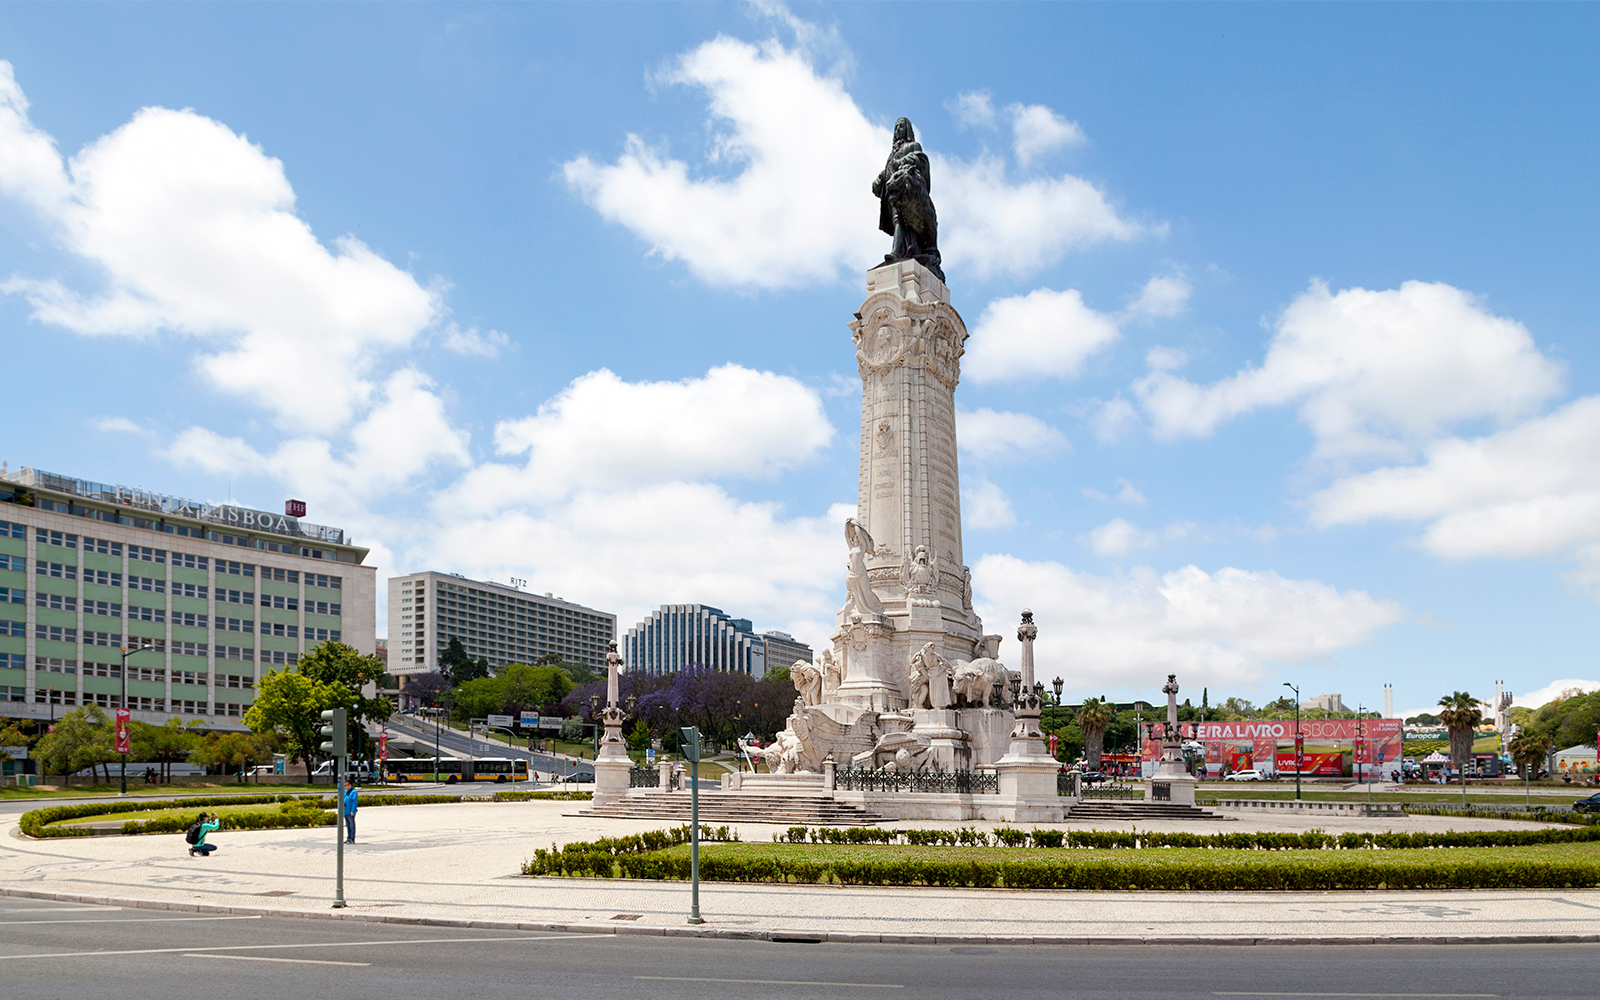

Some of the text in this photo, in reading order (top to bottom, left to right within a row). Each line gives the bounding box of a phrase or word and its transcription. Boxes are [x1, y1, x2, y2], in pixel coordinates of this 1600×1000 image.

[293, 503, 305, 512] HF
[204, 502, 290, 531] LISBOA
[510, 576, 527, 587] RITZ
[1188, 725, 1233, 738] FEIRA
[1236, 724, 1284, 738] LIVRO
[1289, 723, 1346, 737] LISBOA
